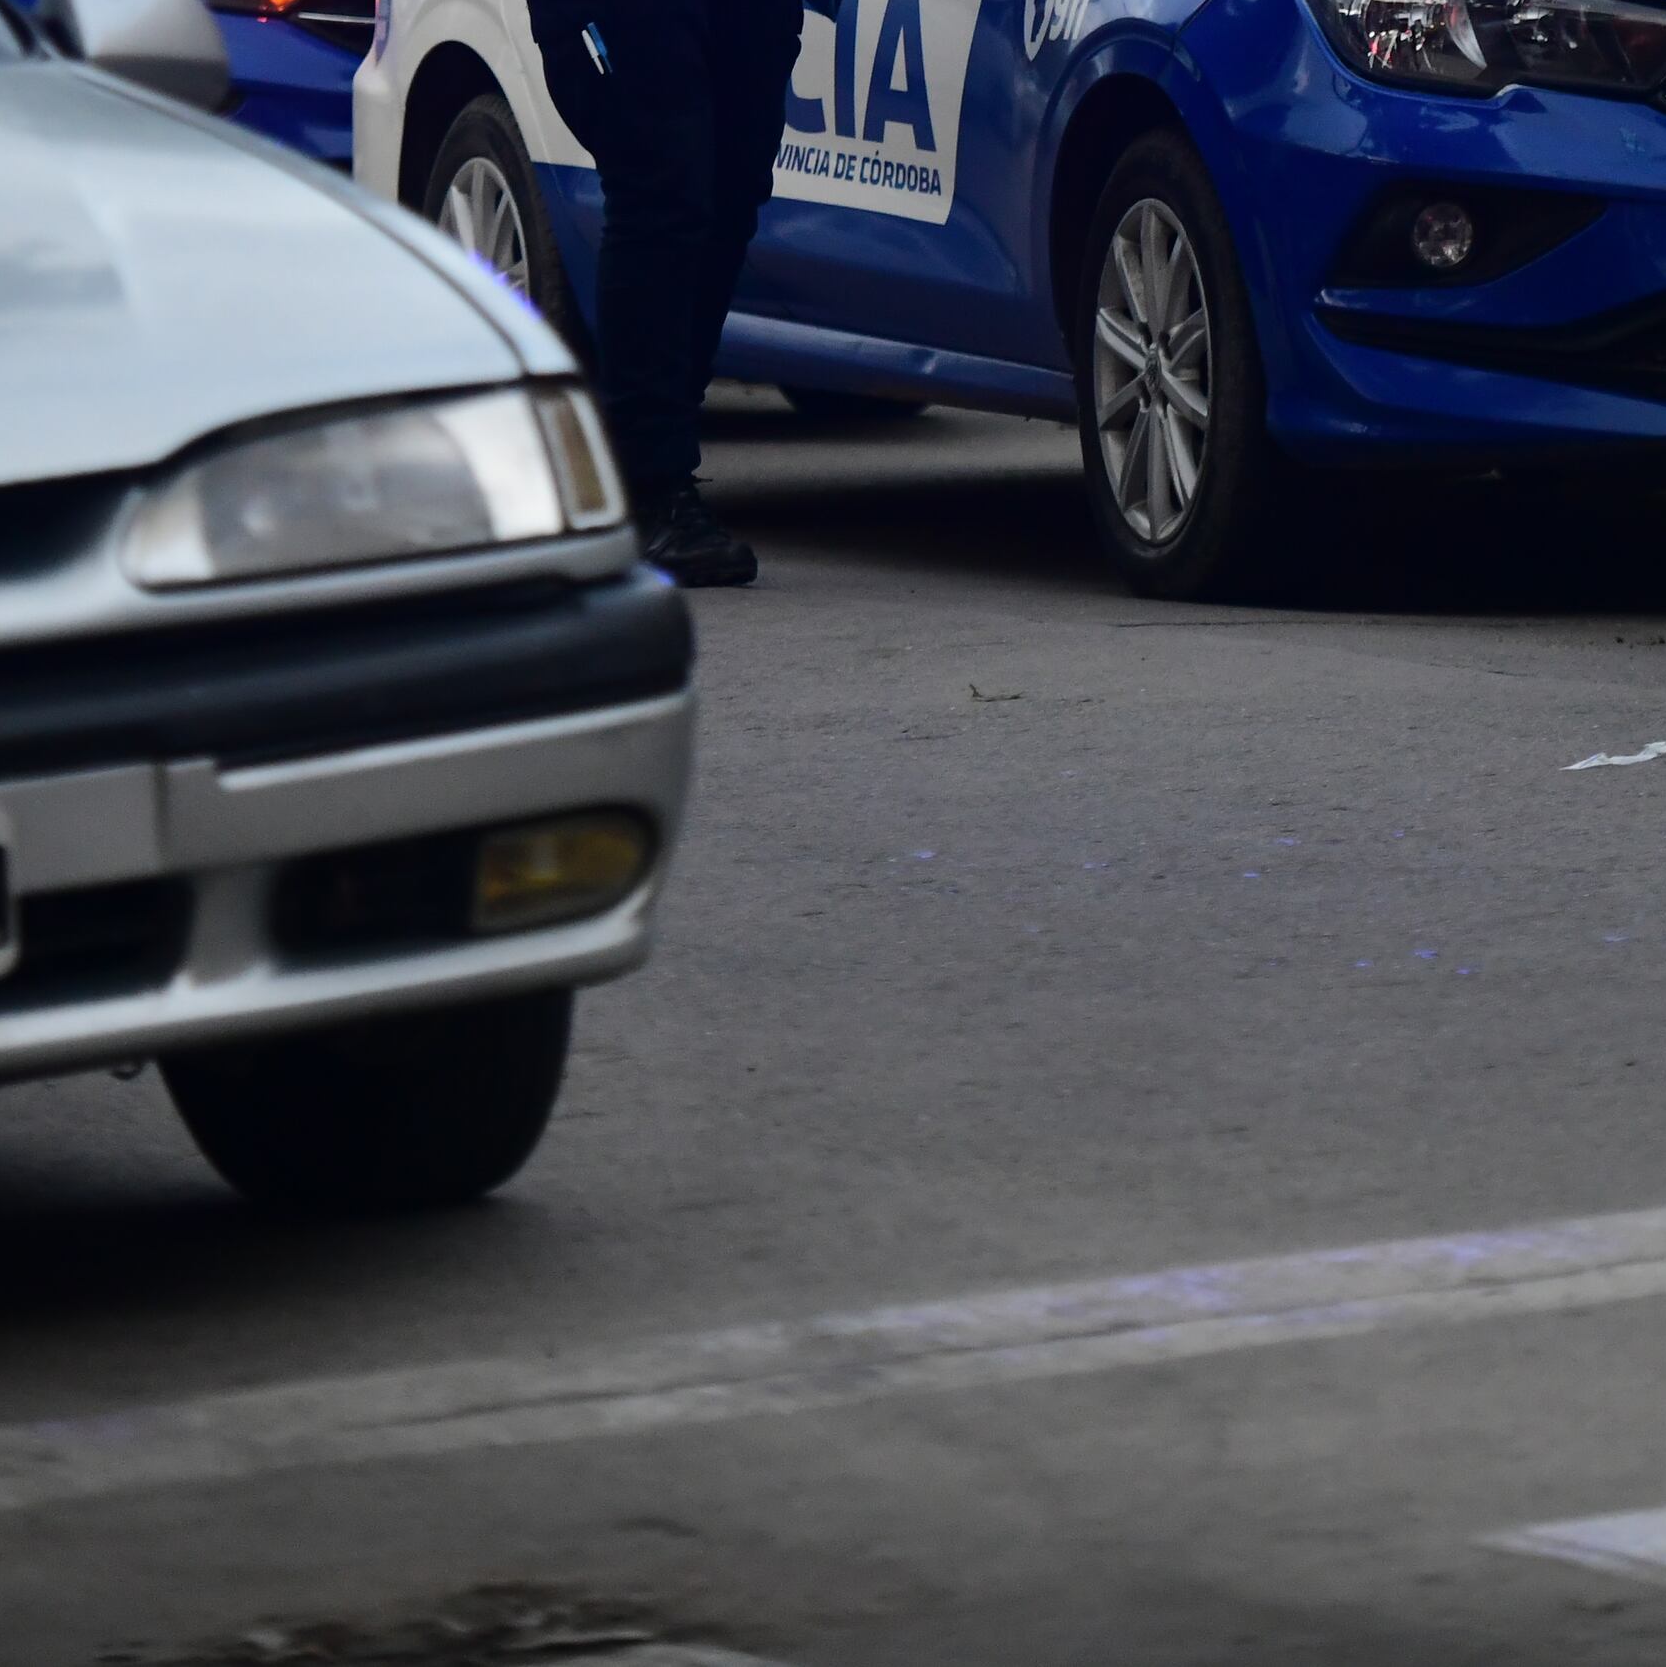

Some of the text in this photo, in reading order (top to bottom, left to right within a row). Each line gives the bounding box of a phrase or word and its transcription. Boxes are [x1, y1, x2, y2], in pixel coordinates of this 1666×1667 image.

[777, 144, 943, 196] VINCIA DE CÓRDOBA
